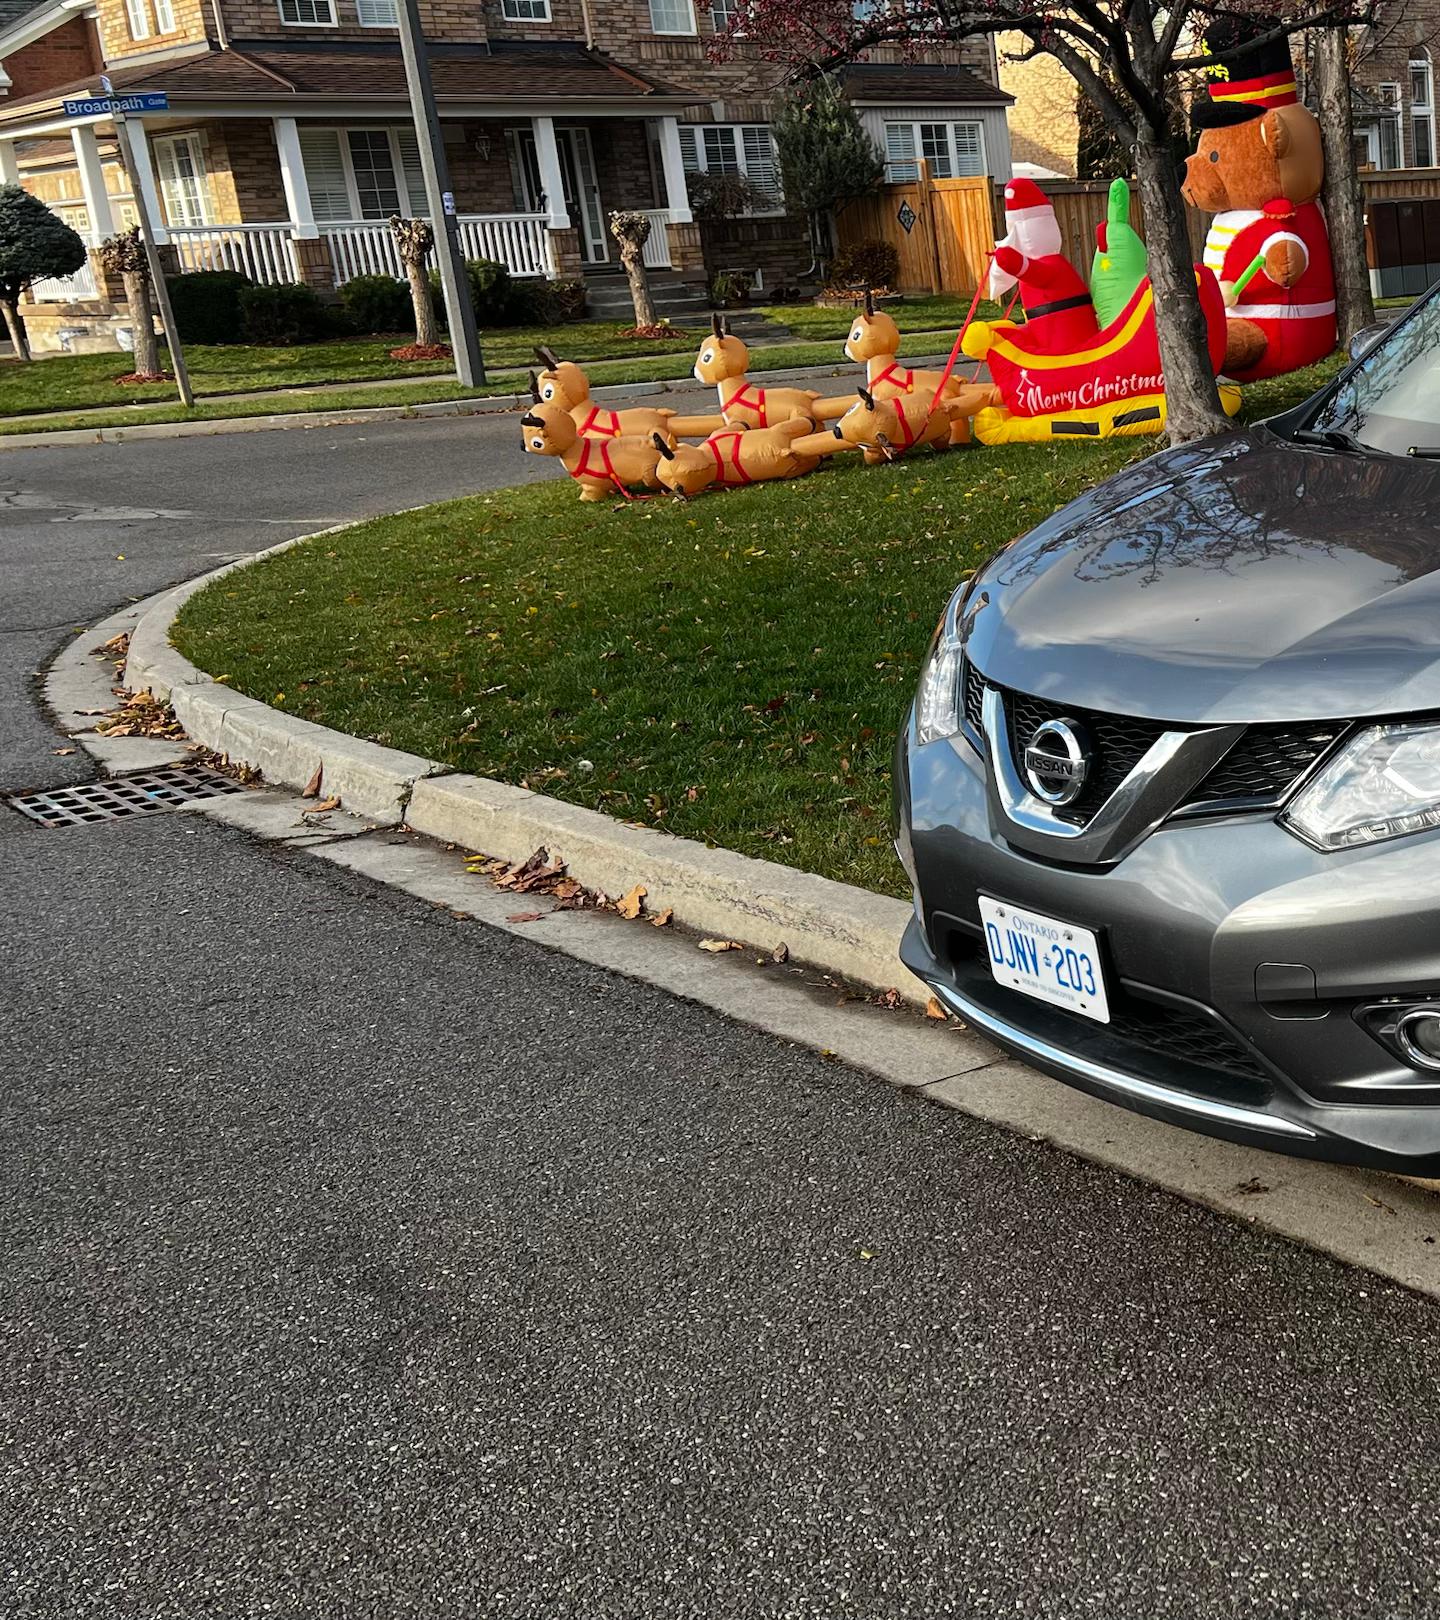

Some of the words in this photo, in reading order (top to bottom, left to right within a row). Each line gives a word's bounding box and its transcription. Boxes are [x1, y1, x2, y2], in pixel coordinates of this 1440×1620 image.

[66, 97, 145, 115] Broadpath
[1026, 385, 1077, 415] Merry
[1078, 373, 1165, 405] Christma
[1028, 754, 1073, 776] NISSAN
[1012, 915, 1060, 941] ONTARIO
[986, 922, 1040, 977] DJNV
[1051, 944, 1096, 996] 203
